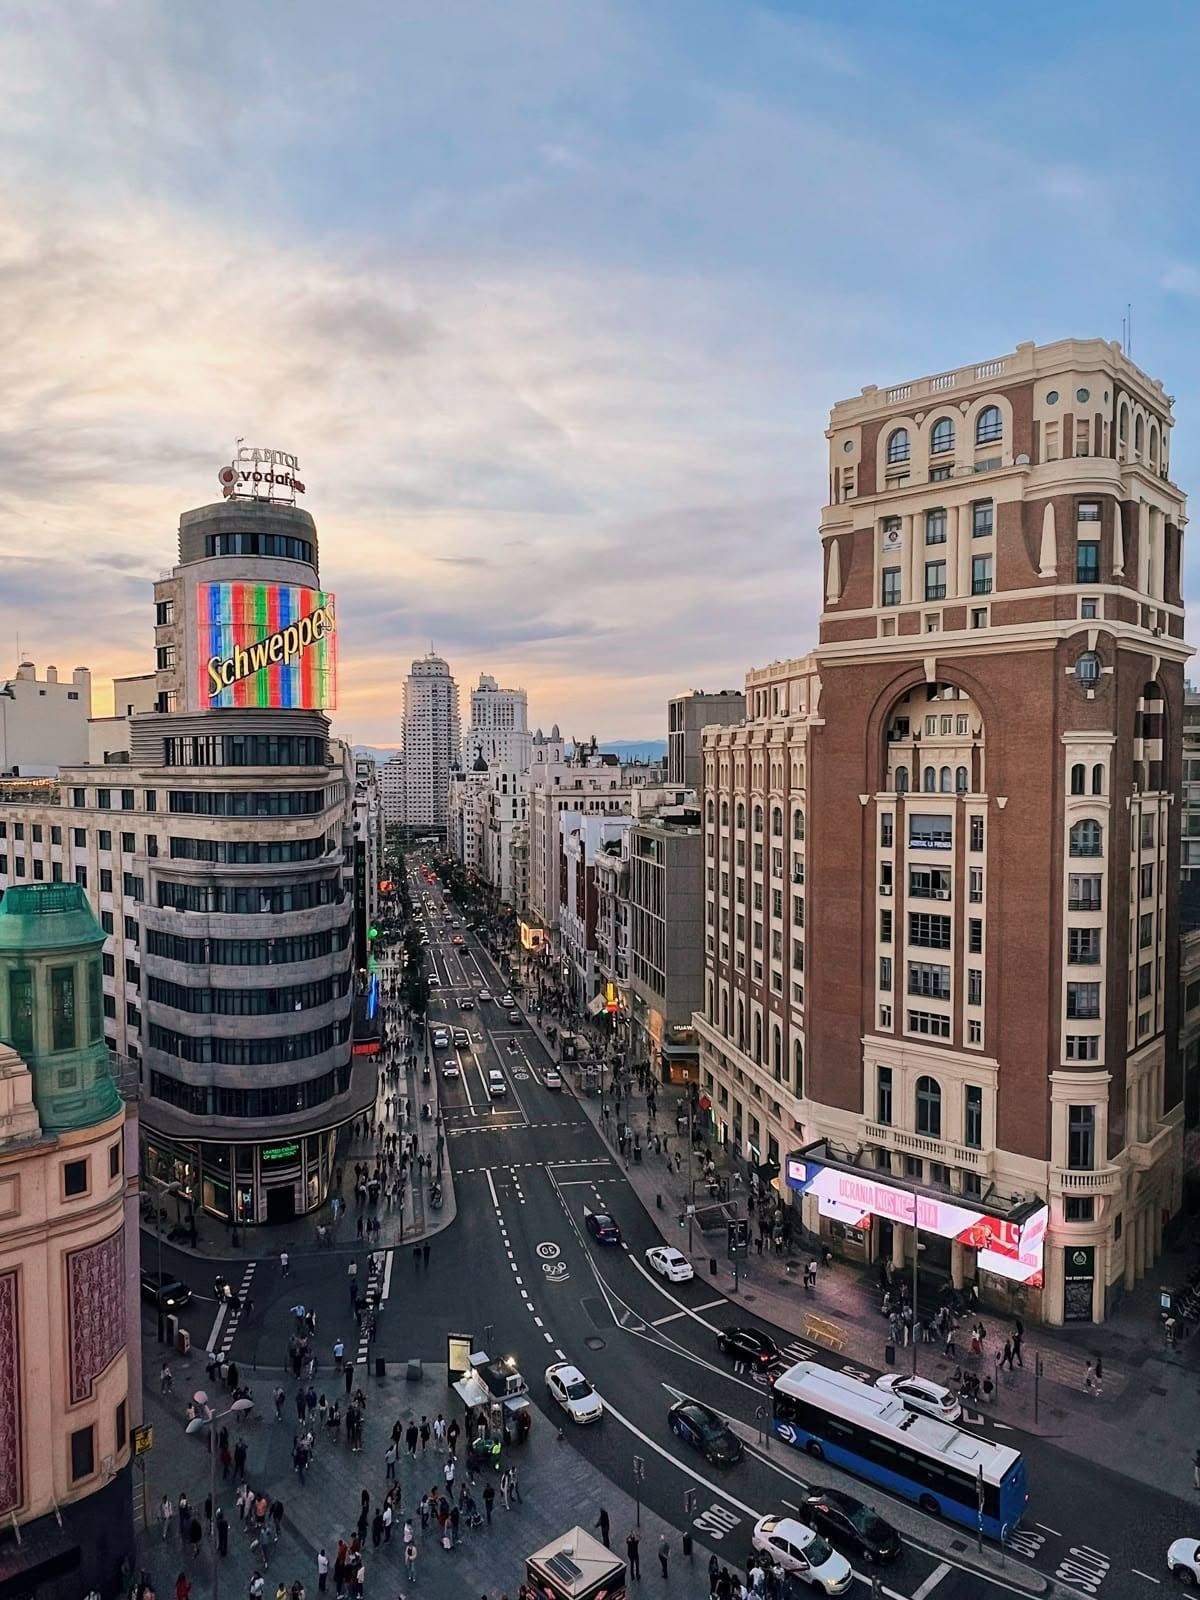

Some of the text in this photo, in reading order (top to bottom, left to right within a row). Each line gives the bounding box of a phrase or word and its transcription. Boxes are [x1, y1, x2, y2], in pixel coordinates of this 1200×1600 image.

[239, 447, 300, 471] CAPITOL
[240, 469, 299, 490] vodafo
[208, 602, 334, 697] Schweppes
[839, 1178, 873, 1207] UCRANIA
[877, 1188, 894, 1212] NOS
[692, 1503, 742, 1540] BUS
[1055, 1545, 1111, 1593] SOLO
